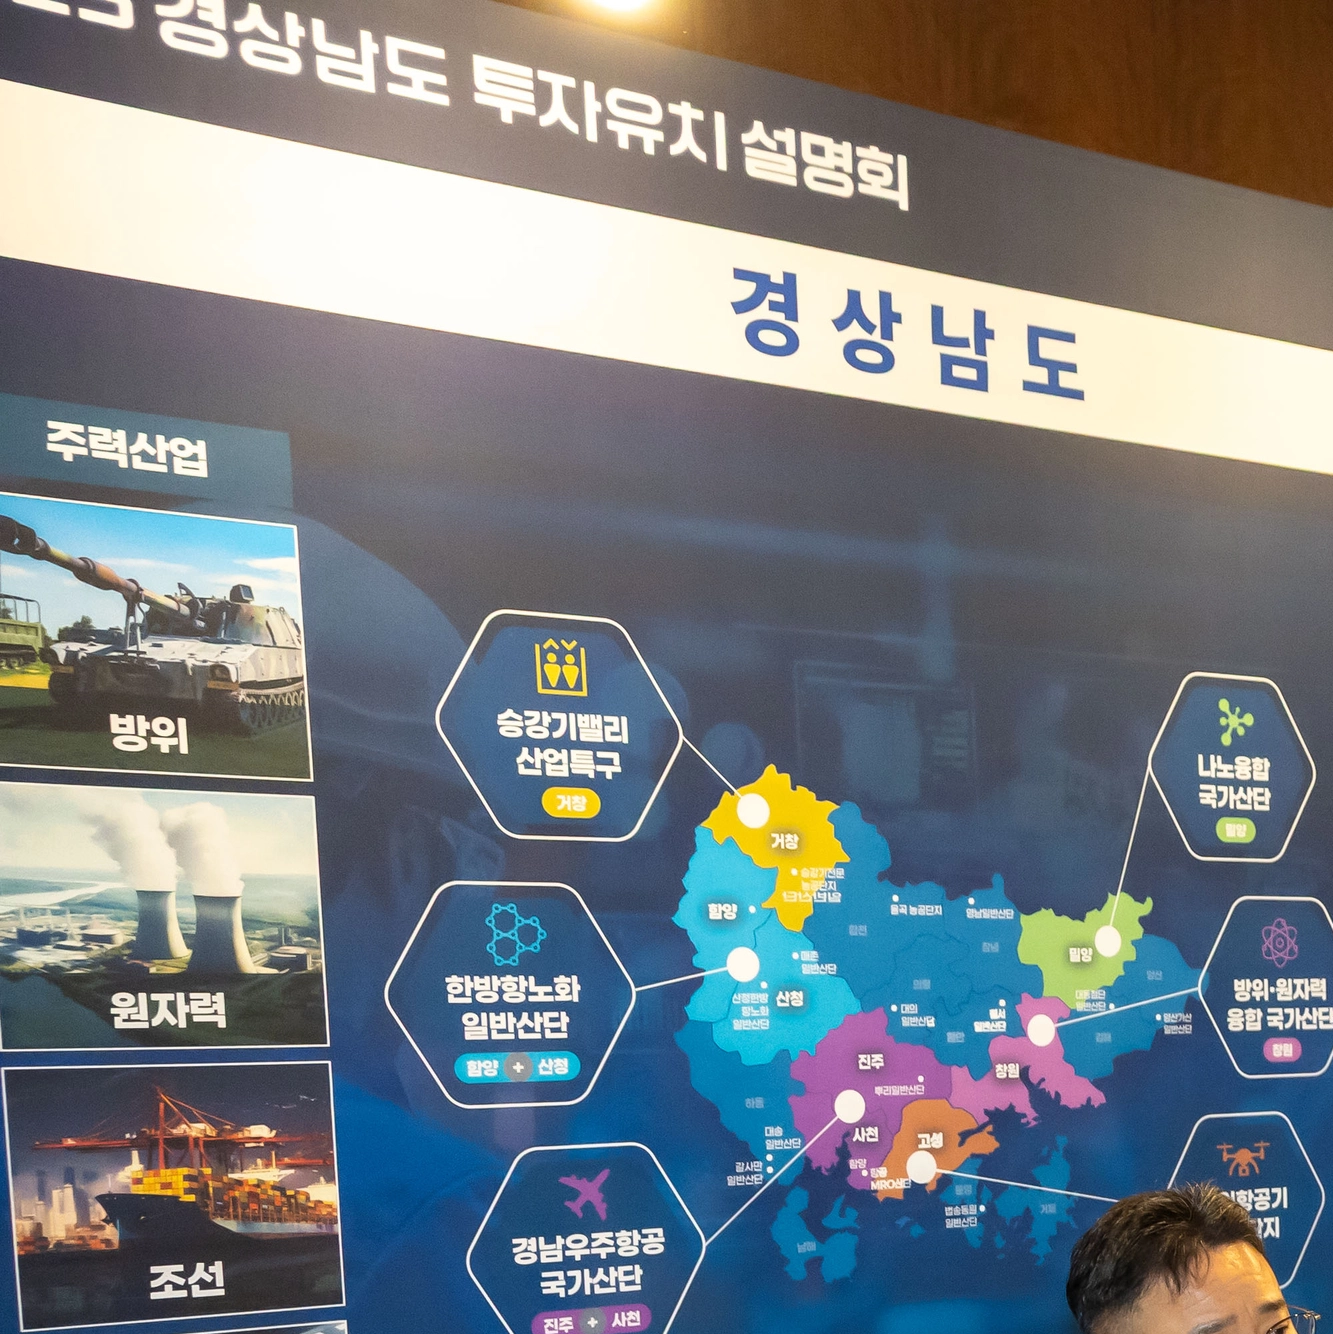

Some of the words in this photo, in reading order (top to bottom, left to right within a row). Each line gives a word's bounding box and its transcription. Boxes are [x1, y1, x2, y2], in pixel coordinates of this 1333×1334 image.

[473, 54, 727, 171] 투자유치
[741, 119, 910, 211] 설명회
[731, 267, 1085, 402] 경상남도
[46, 420, 208, 478] 주력산업
[109, 713, 189, 754] 방위
[497, 708, 629, 745] 승강기밸리
[516, 747, 622, 780] 산업특구
[1197, 753, 1271, 781] 나노융합
[556, 794, 587, 812] 거창
[1198, 784, 1271, 811] 국가산단
[1225, 822, 1247, 838] 밀양
[771, 833, 799, 850] 거창
[708, 903, 738, 920] 함양
[909, 904, 942, 916] 농공단지
[1069, 948, 1093, 963] 밀양
[801, 964, 837, 975] 일반산단
[445, 974, 582, 1004] 한방항노화
[1233, 978, 1328, 1002] 방위·원자력
[776, 991, 804, 1007] 산청
[110, 991, 227, 1029] 원자력
[1227, 1007, 1264, 1032] 융합
[462, 1010, 570, 1041] 일반산단
[732, 1019, 770, 1030] 일반산단
[1272, 1043, 1294, 1058] 창원
[466, 1059, 499, 1077] 함양
[537, 1058, 569, 1075] 산청
[857, 1054, 885, 1070] 진주
[995, 1063, 1020, 1078] 창원
[765, 1138, 802, 1149] 일반산단
[852, 1127, 879, 1143] 사천
[917, 1133, 943, 1149] 고성
[727, 1175, 764, 1186] 일반산단
[945, 1217, 978, 1228] 일반산단
[511, 1227, 665, 1265] 경남우주항공
[150, 1261, 226, 1300] 조선
[540, 1264, 643, 1298] 국가산단
[543, 1316, 574, 1334] 진주
[611, 1310, 641, 1328] 사천
